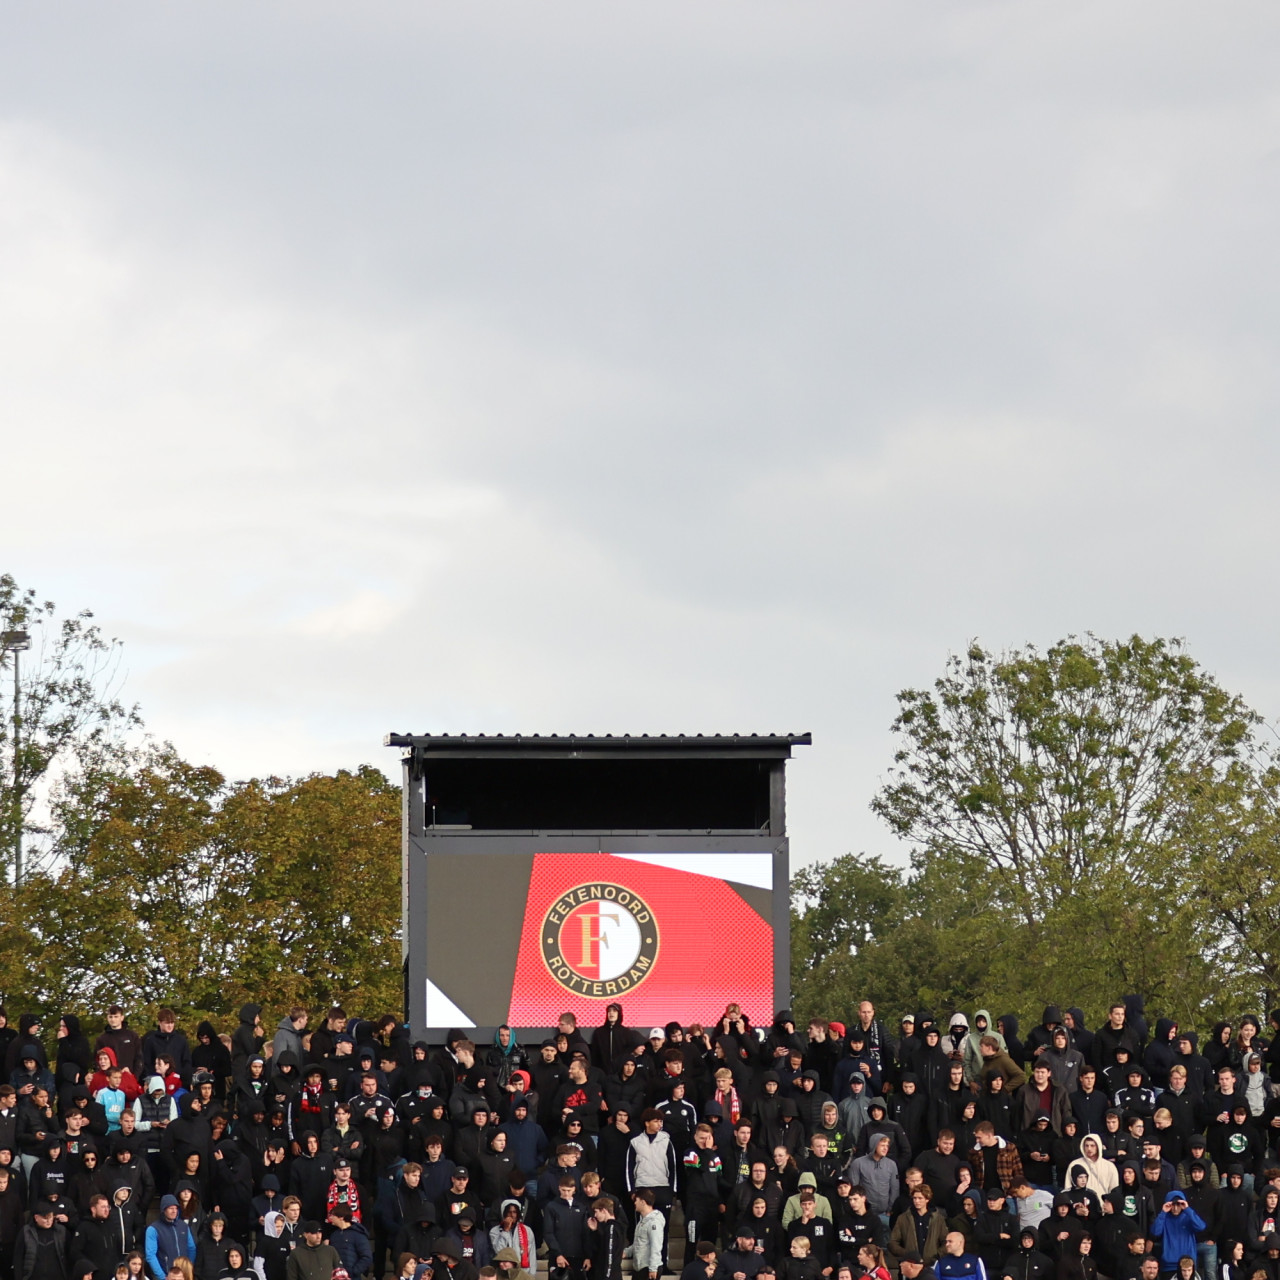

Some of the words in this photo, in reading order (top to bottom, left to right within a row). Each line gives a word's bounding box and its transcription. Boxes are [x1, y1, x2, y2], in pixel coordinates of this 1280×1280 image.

[549, 886, 650, 924] FEYENOORD
[576, 913, 620, 967] F
[549, 956, 651, 995] ROTTERDAM
